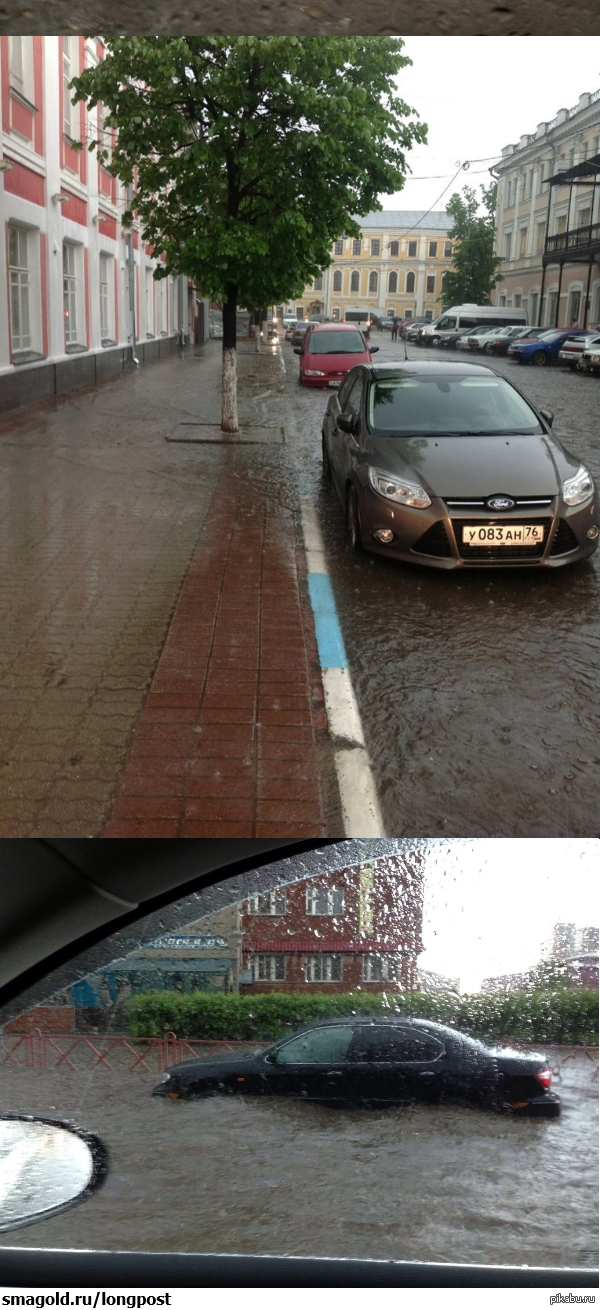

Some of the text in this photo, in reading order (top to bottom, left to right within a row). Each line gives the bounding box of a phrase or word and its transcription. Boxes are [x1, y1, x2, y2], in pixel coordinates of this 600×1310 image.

[494, 498, 509, 507] Ford
[478, 528, 503, 540] 083
[525, 527, 538, 537] 76
